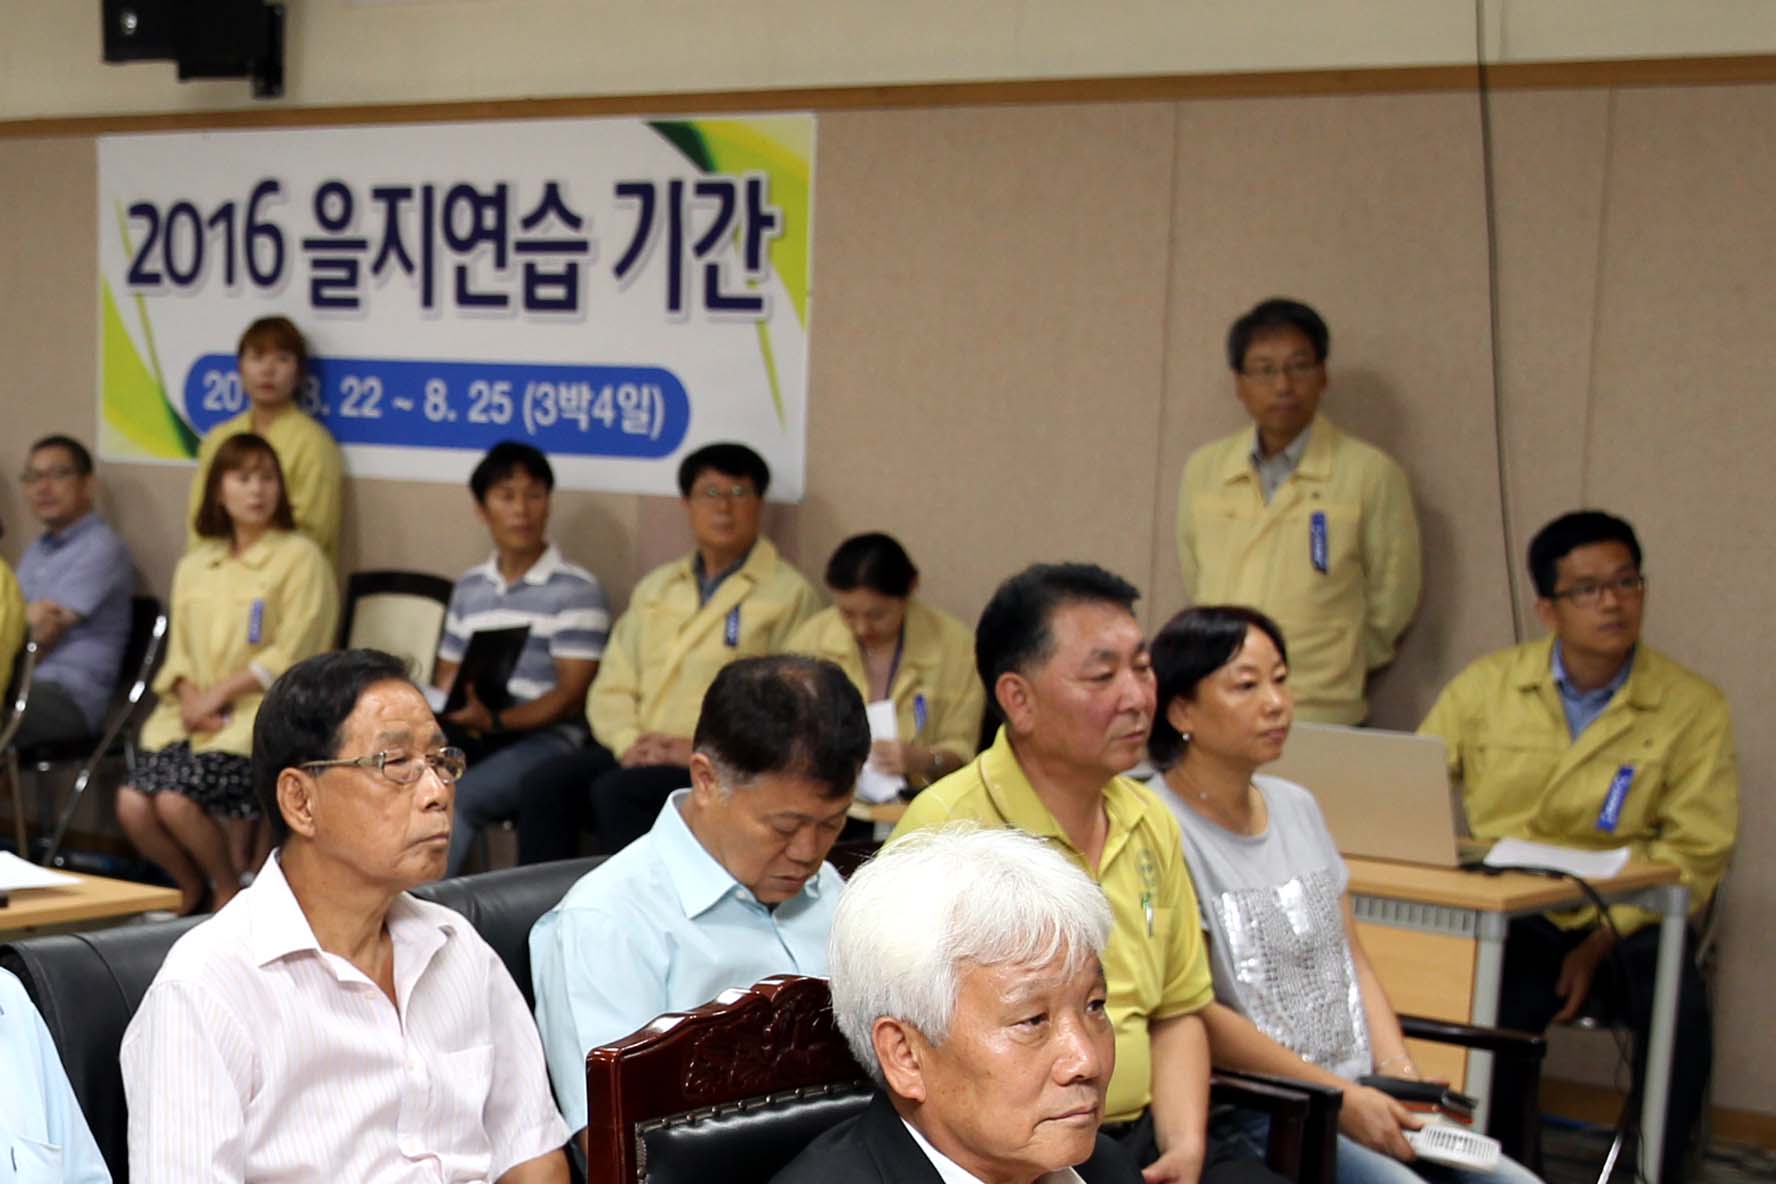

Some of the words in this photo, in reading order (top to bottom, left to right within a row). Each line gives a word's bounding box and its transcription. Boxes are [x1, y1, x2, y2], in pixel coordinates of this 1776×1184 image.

[127, 178, 285, 288] 2016
[302, 180, 589, 312] 을지연습
[612, 178, 775, 312] 기간
[338, 375, 384, 419] 22
[423, 377, 458, 423] 8.
[467, 379, 514, 425] 25
[522, 380, 666, 440] (3박4일)
